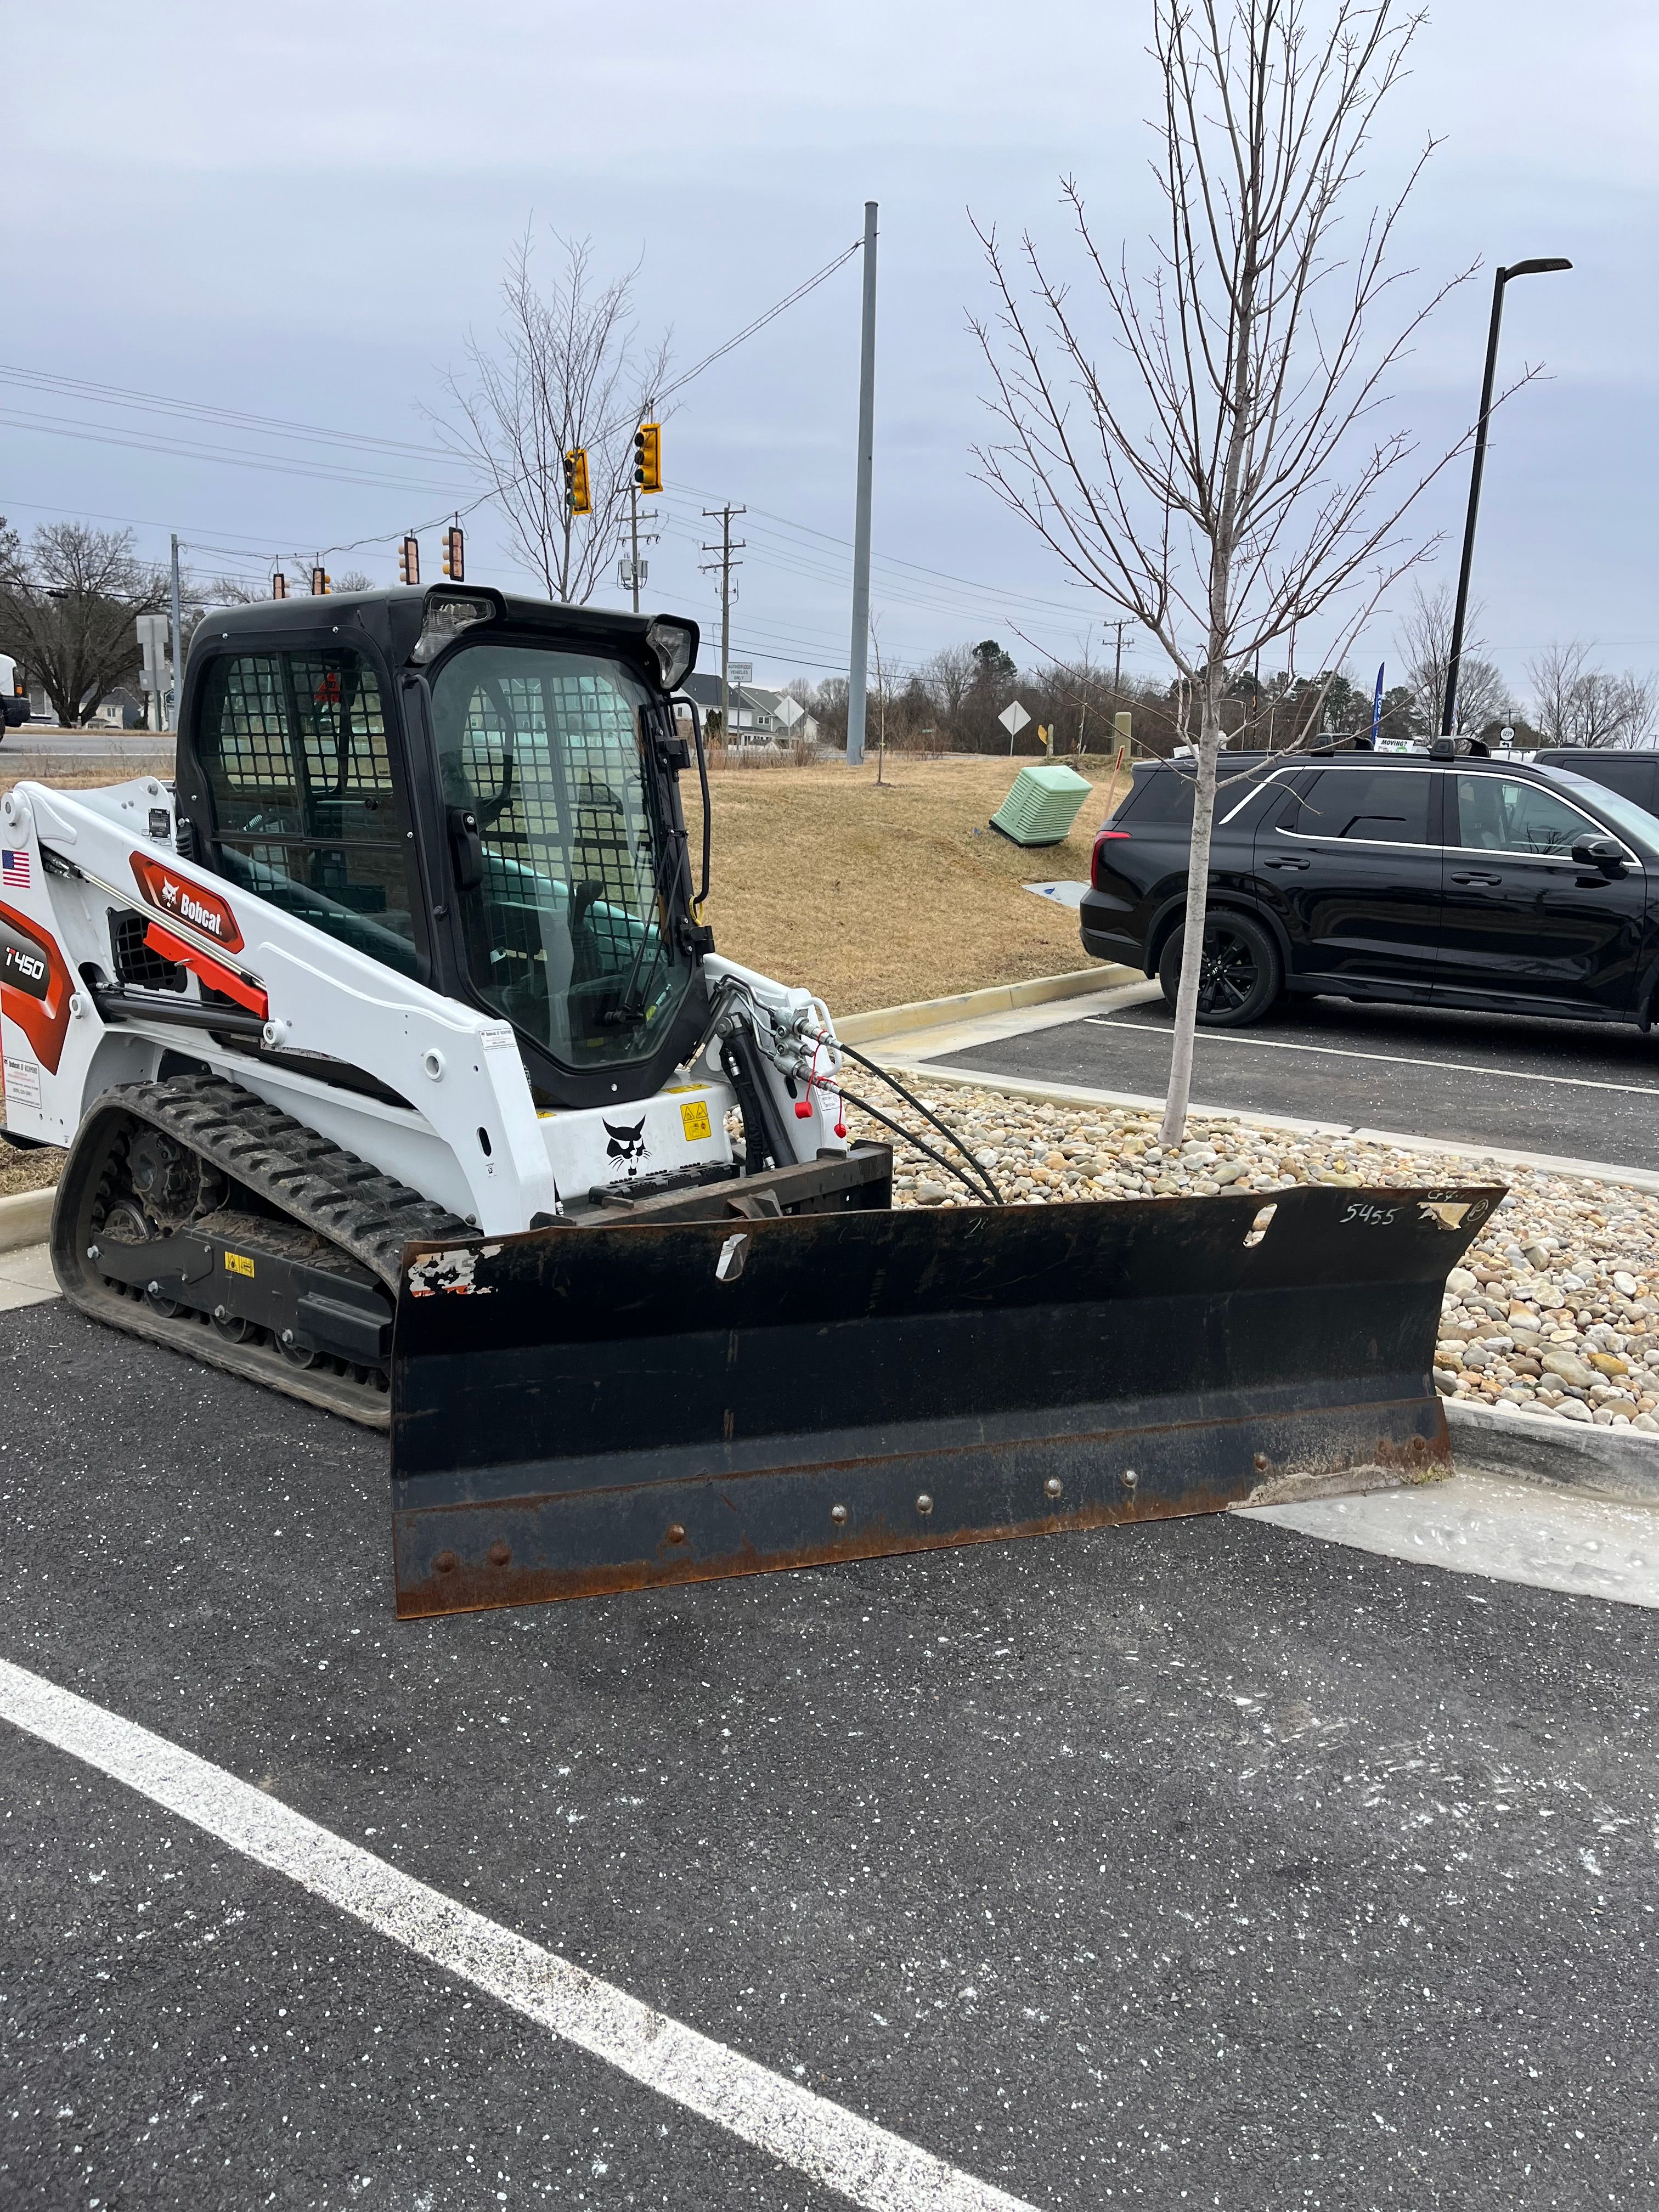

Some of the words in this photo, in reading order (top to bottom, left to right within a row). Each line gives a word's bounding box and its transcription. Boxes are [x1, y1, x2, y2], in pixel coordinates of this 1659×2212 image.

[180, 893, 221, 935] Bobcat
[6, 947, 44, 980] T450
[1339, 1203, 1404, 1225] 5455
